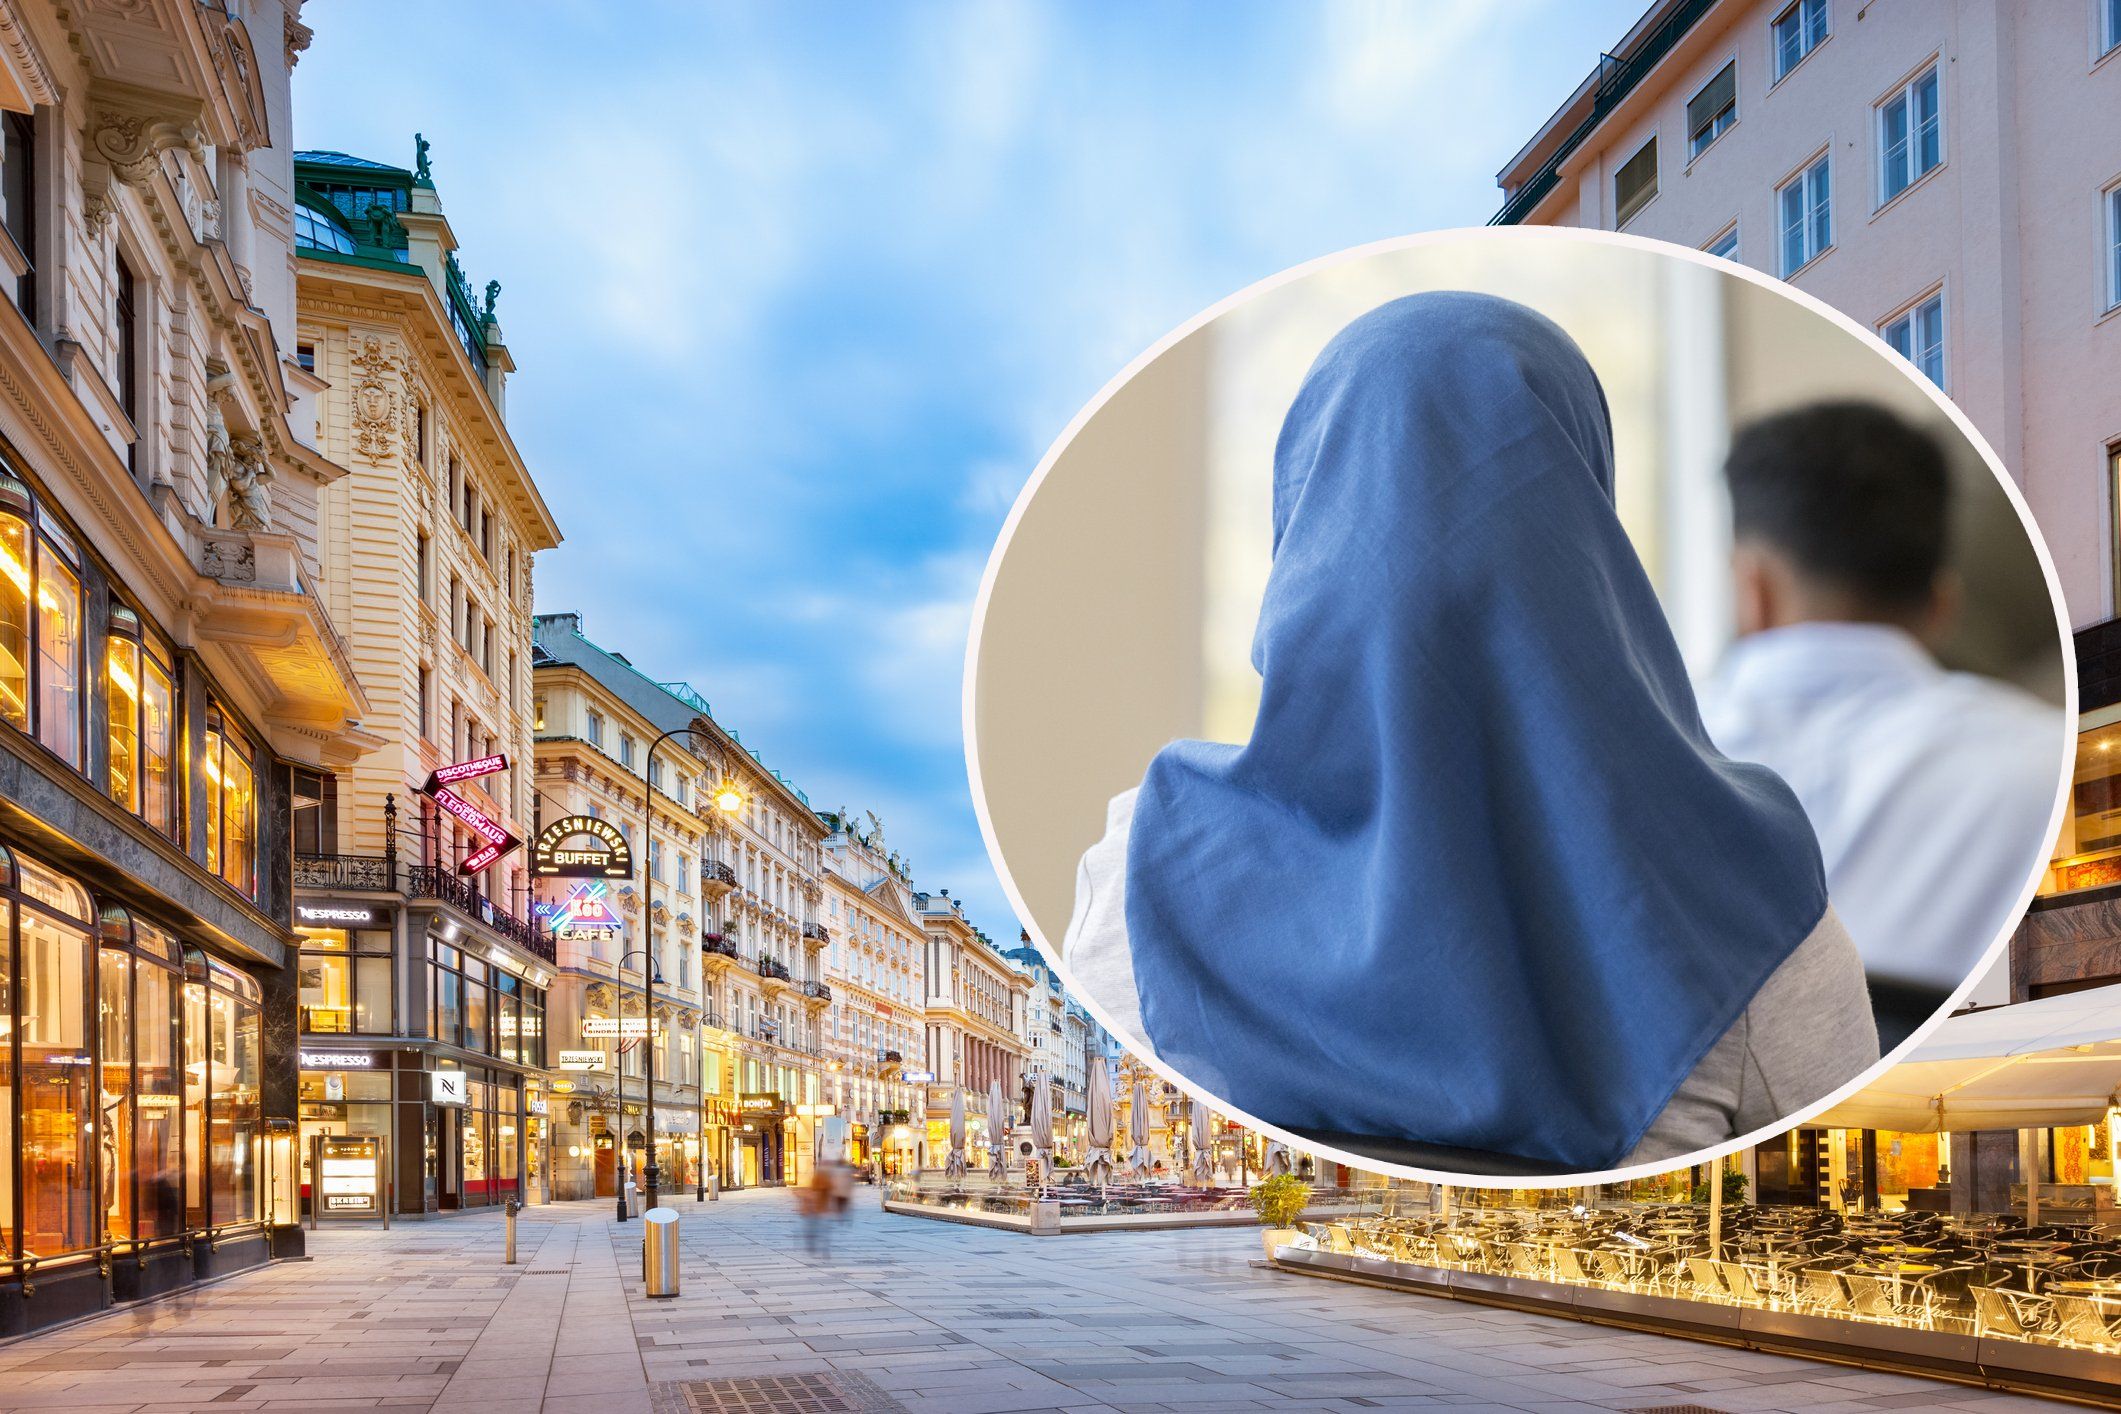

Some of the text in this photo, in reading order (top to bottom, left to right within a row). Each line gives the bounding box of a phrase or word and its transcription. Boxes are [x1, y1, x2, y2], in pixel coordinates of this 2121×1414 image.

[436, 757, 502, 779] DISCOTHEQUE
[434, 790, 506, 845] FLEDERMAUS
[478, 847, 496, 860] BAR
[554, 851, 610, 866] BUFFET
[297, 907, 370, 921] NESPRESSO
[300, 1053, 370, 1067] NESPRESSO
